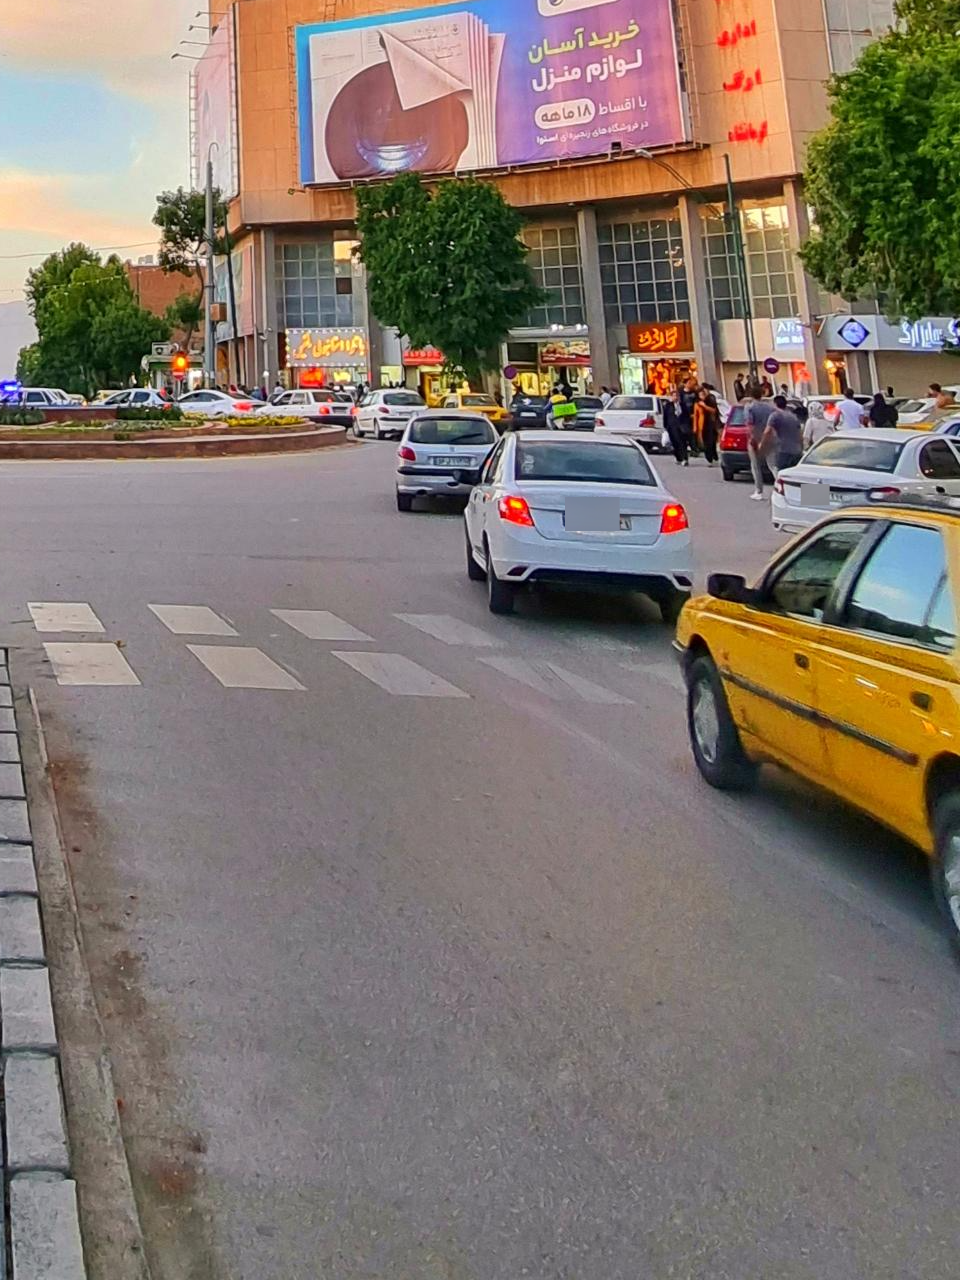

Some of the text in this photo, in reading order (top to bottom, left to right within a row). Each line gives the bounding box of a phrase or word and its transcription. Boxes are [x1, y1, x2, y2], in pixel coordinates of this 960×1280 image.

[528, 19, 640, 64] خرید آسان
[716, 19, 757, 47] اداری
[532, 48, 643, 92] لوازم منزل
[541, 106, 575, 123] ماهه
[598, 97, 636, 116] اقساط
[638, 95, 648, 111] با
